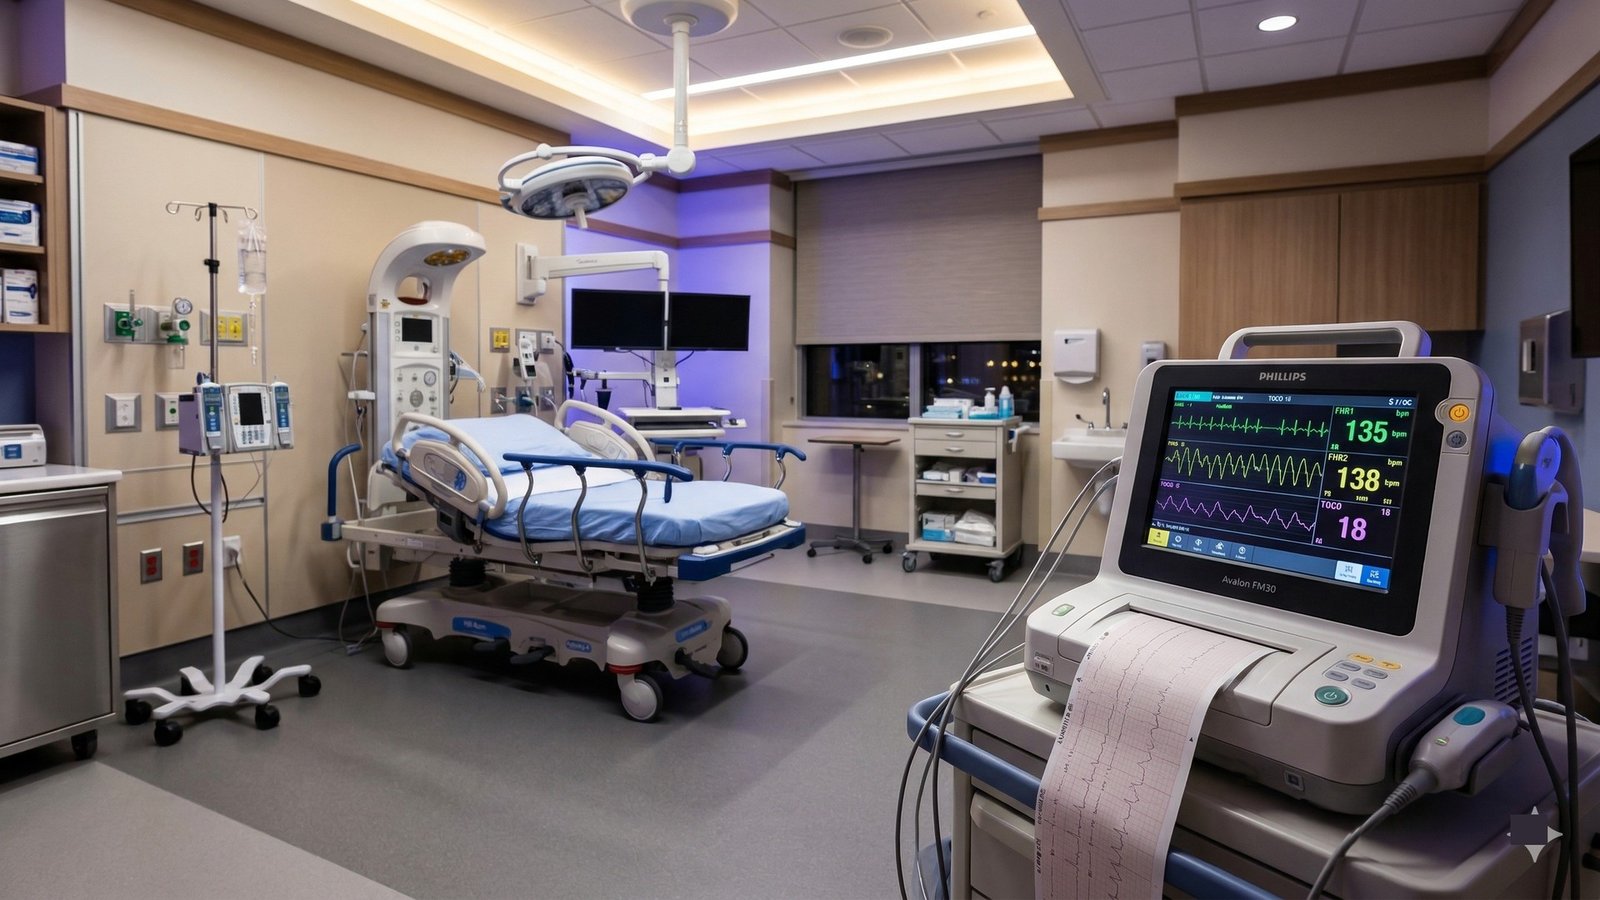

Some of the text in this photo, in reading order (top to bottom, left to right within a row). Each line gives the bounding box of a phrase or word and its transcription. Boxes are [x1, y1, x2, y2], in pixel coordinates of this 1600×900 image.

[1259, 372, 1306, 381] PHILLIPS
[1335, 407, 1354, 415] FHR1
[1346, 419, 1407, 443] 135 bpm
[1328, 453, 1348, 462] FHR2
[1387, 458, 1402, 467] bpm
[1337, 466, 1380, 492] 138
[1321, 500, 1342, 510] TOCO
[1381, 508, 1391, 516] 18
[1338, 516, 1367, 541] 18
[1221, 575, 1277, 594] Avalon FM30
